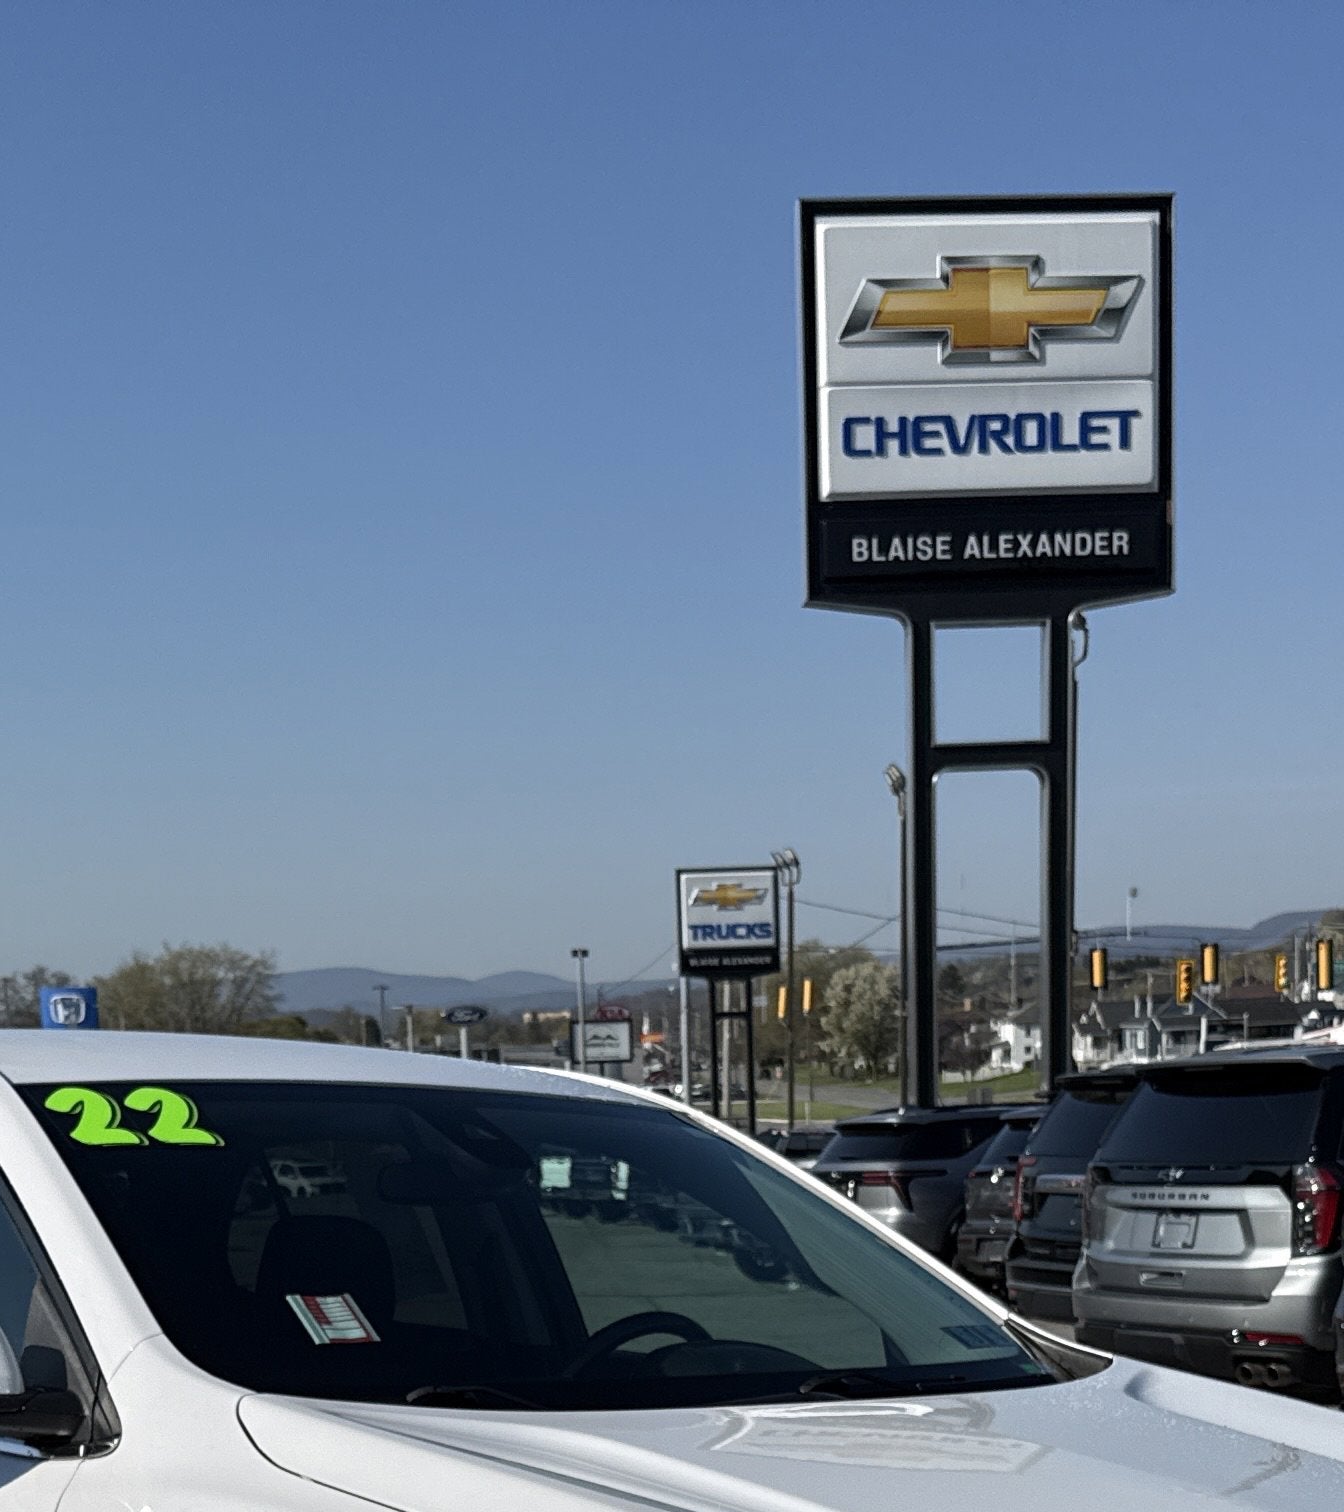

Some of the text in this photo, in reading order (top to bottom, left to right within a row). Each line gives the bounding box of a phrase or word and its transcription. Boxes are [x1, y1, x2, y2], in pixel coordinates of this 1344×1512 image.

[841, 409, 1143, 460] CHEVROLET
[851, 530, 1131, 563] BLAISE ALEXANDER
[688, 923, 773, 941] TRUCKS
[44, 1086, 225, 1146] 22
[1131, 1191, 1210, 1201] SUBURBAN
